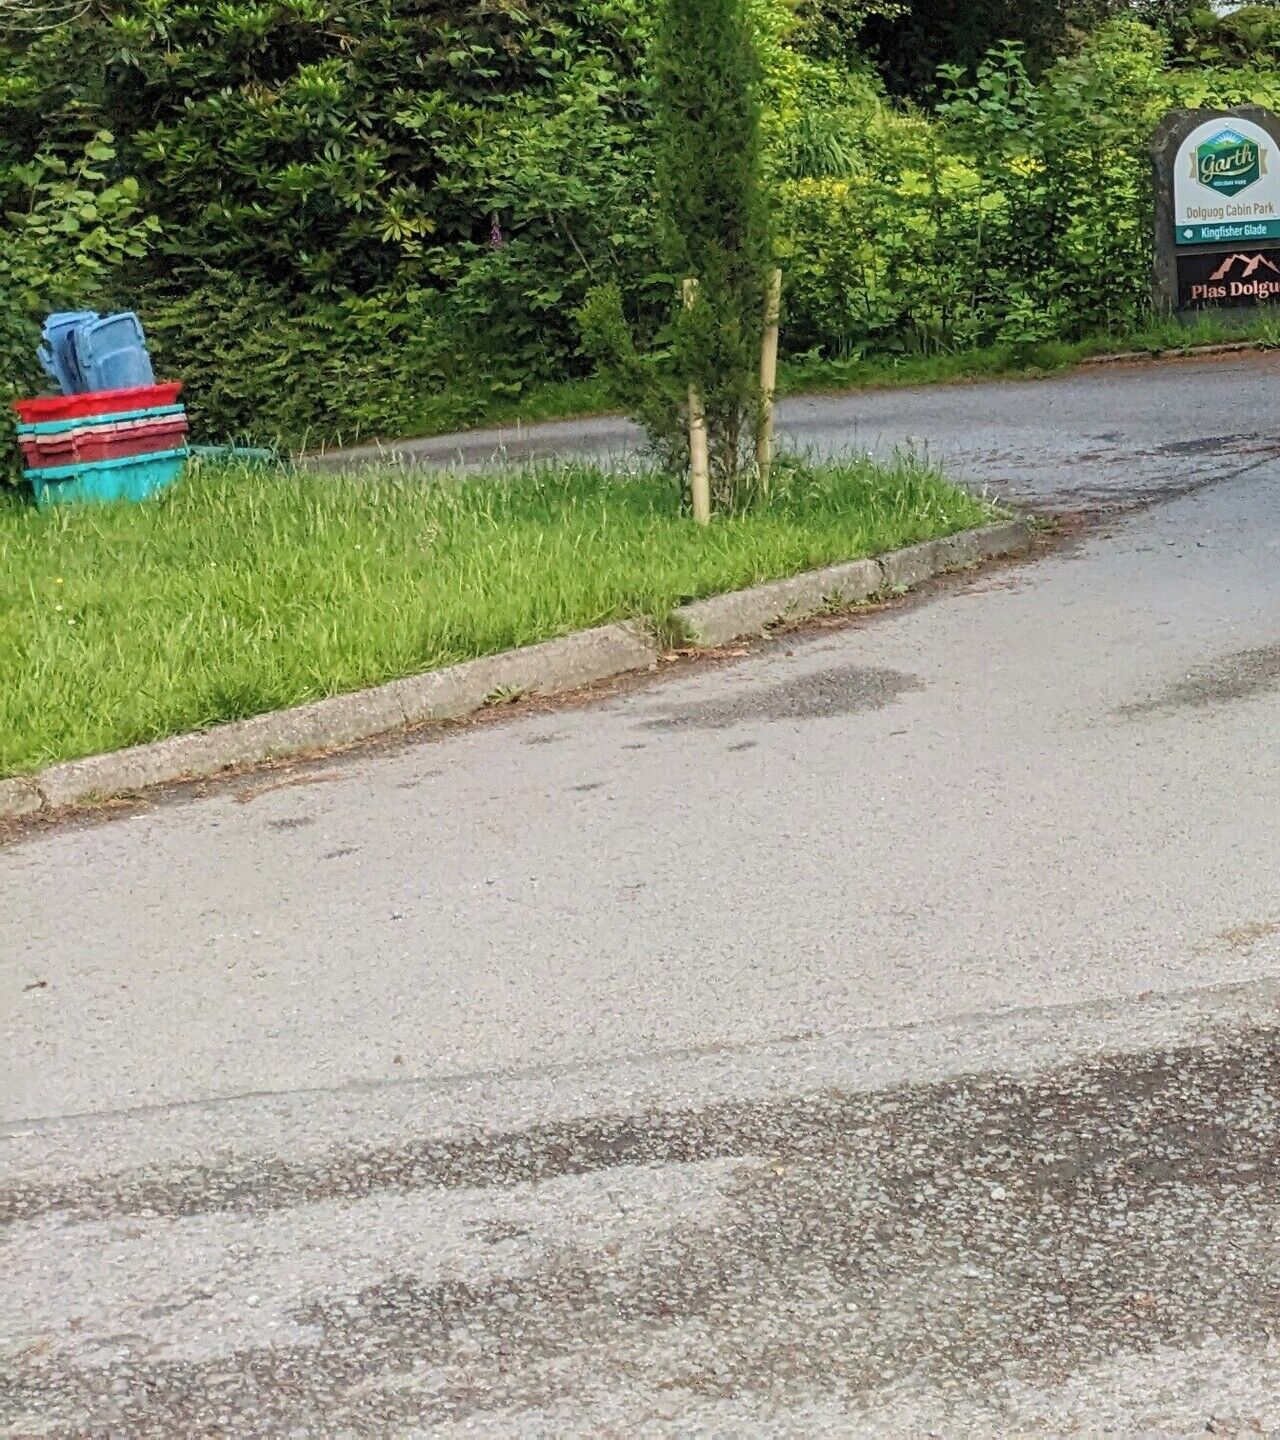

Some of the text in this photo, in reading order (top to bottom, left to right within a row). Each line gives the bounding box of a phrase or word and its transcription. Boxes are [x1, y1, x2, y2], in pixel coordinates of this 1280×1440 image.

[1186, 201, 1274, 220] Dolguog Cabin Park
[1201, 223, 1267, 240] Kingfisher Glade
[1192, 284, 1227, 299] Plas
